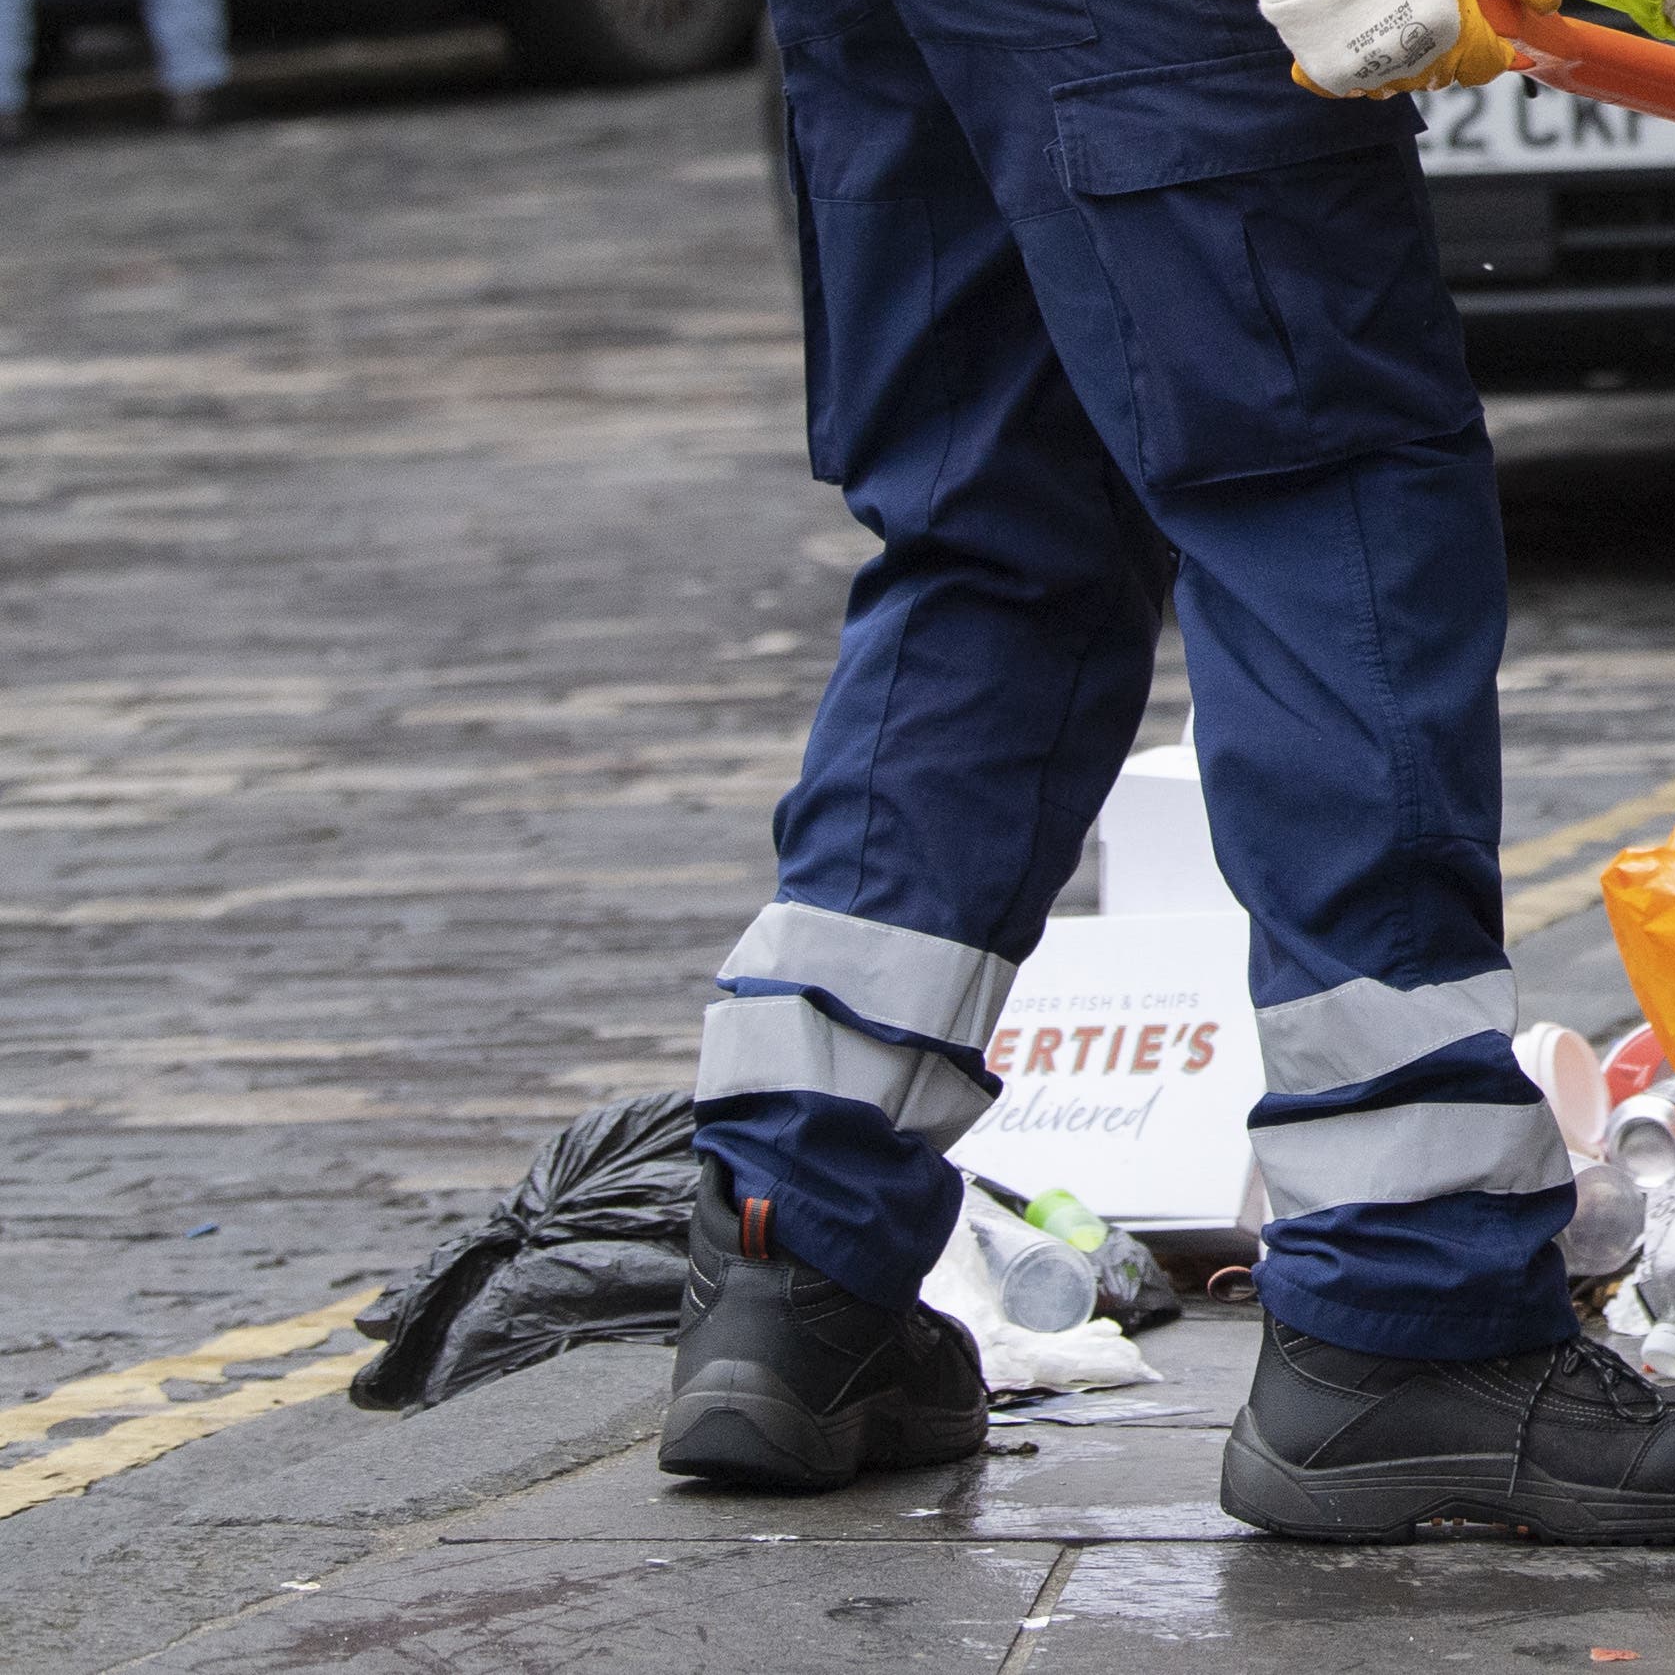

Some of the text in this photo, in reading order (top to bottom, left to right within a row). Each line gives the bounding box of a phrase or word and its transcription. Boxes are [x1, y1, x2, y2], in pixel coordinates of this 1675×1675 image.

[1009, 992, 1200, 1013] OPER FISH & CHIPS
[984, 1021, 1220, 1076] ERTIE'S
